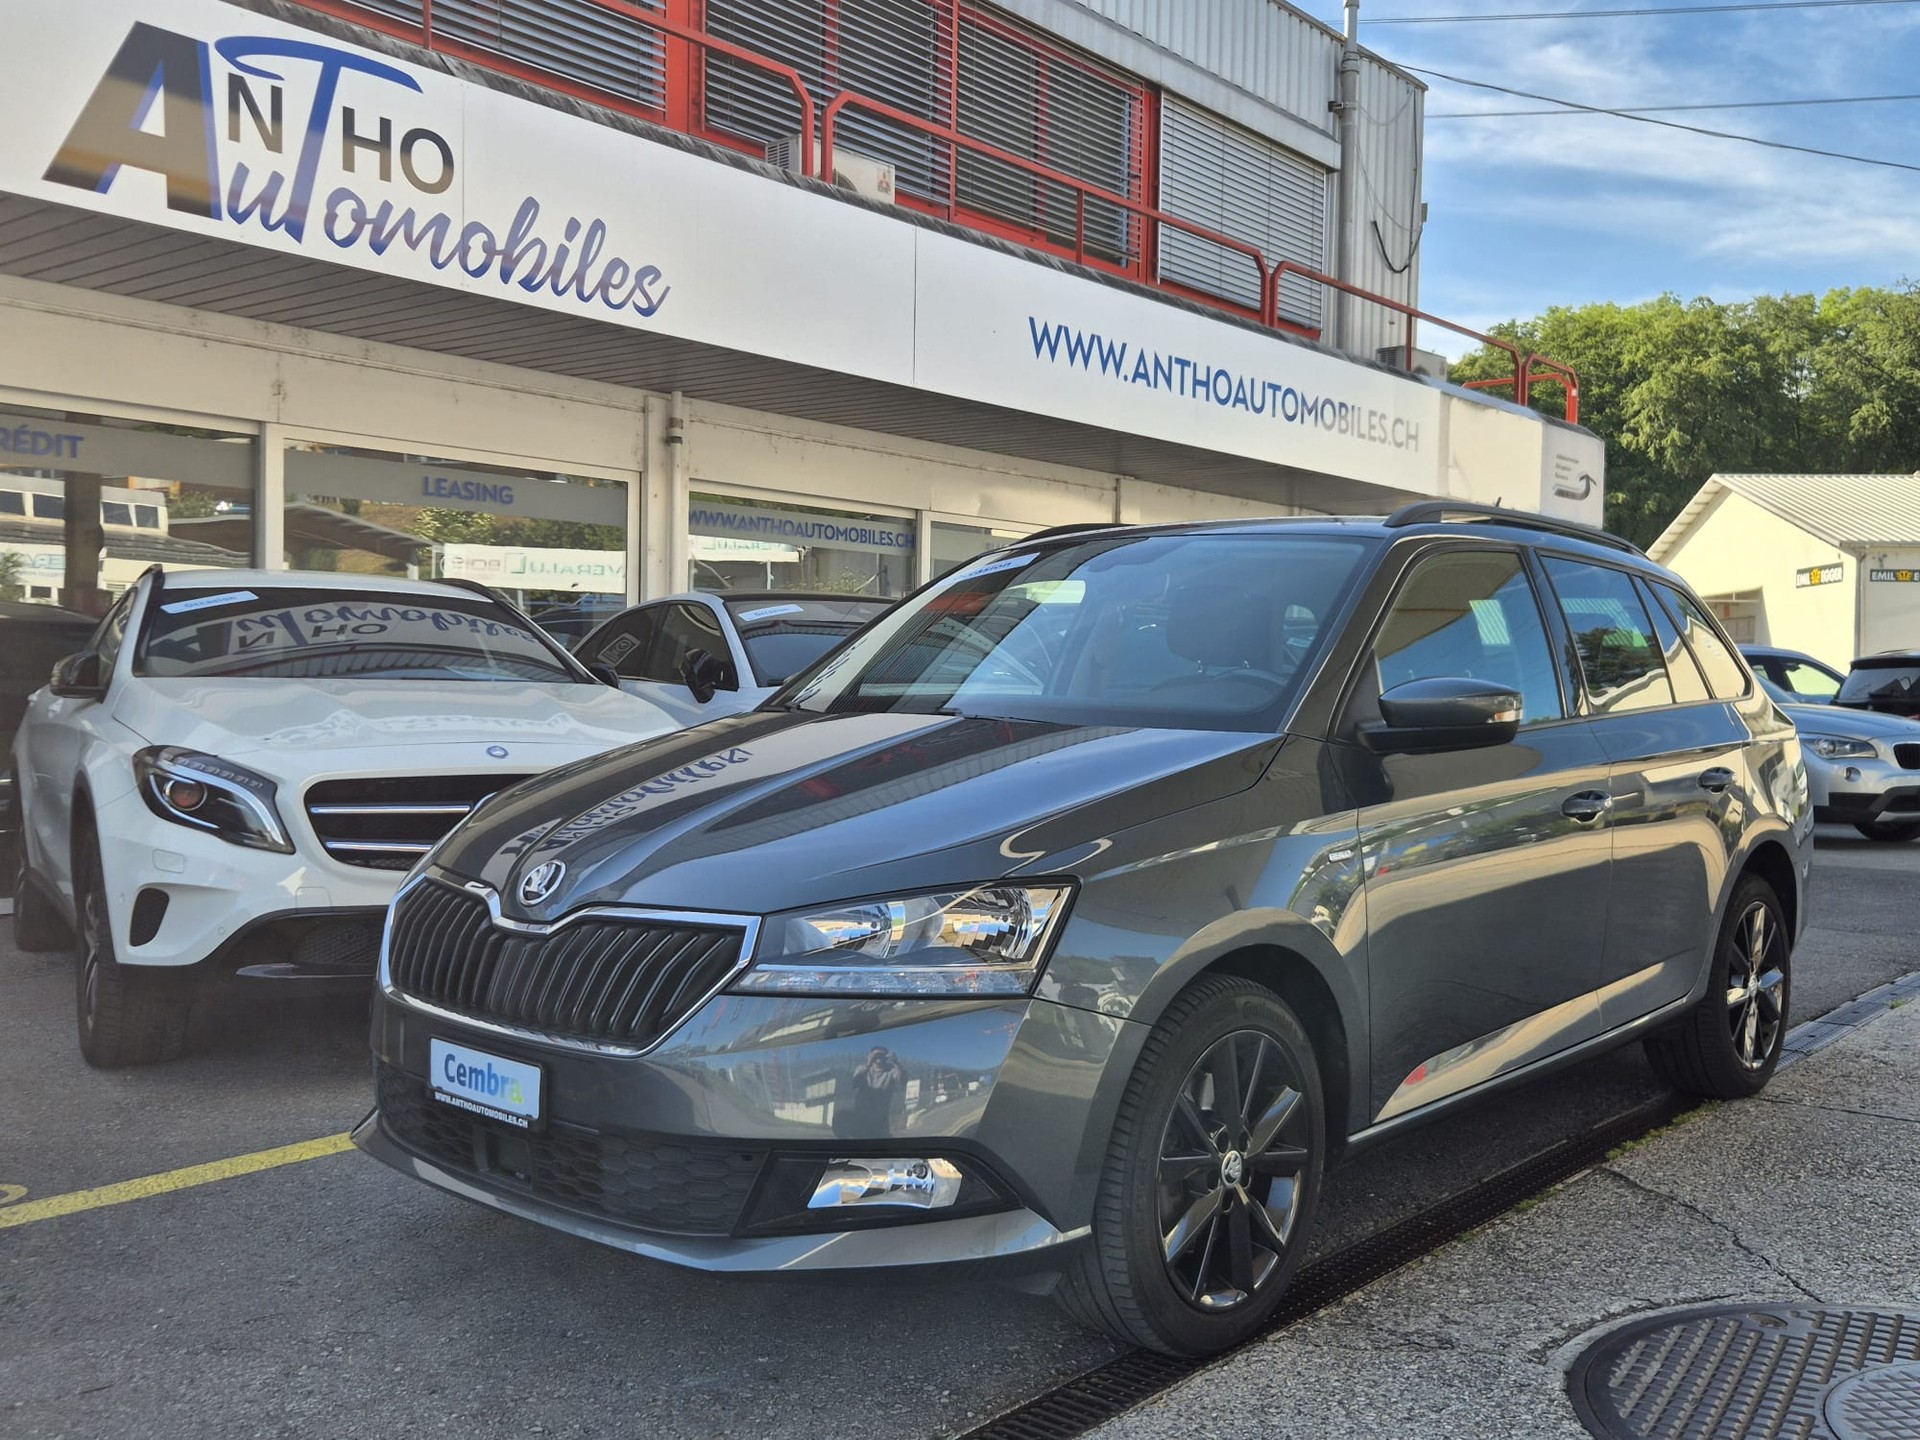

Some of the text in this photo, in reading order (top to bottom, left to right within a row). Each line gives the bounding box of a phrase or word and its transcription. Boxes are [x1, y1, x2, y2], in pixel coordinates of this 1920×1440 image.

[1028, 316, 1420, 453] WWW.ANTHOAUTOMOBILES.CH
[423, 476, 515, 505] LEASING
[1871, 570, 1895, 581] EMIL
[444, 1053, 524, 1104] Cembra
